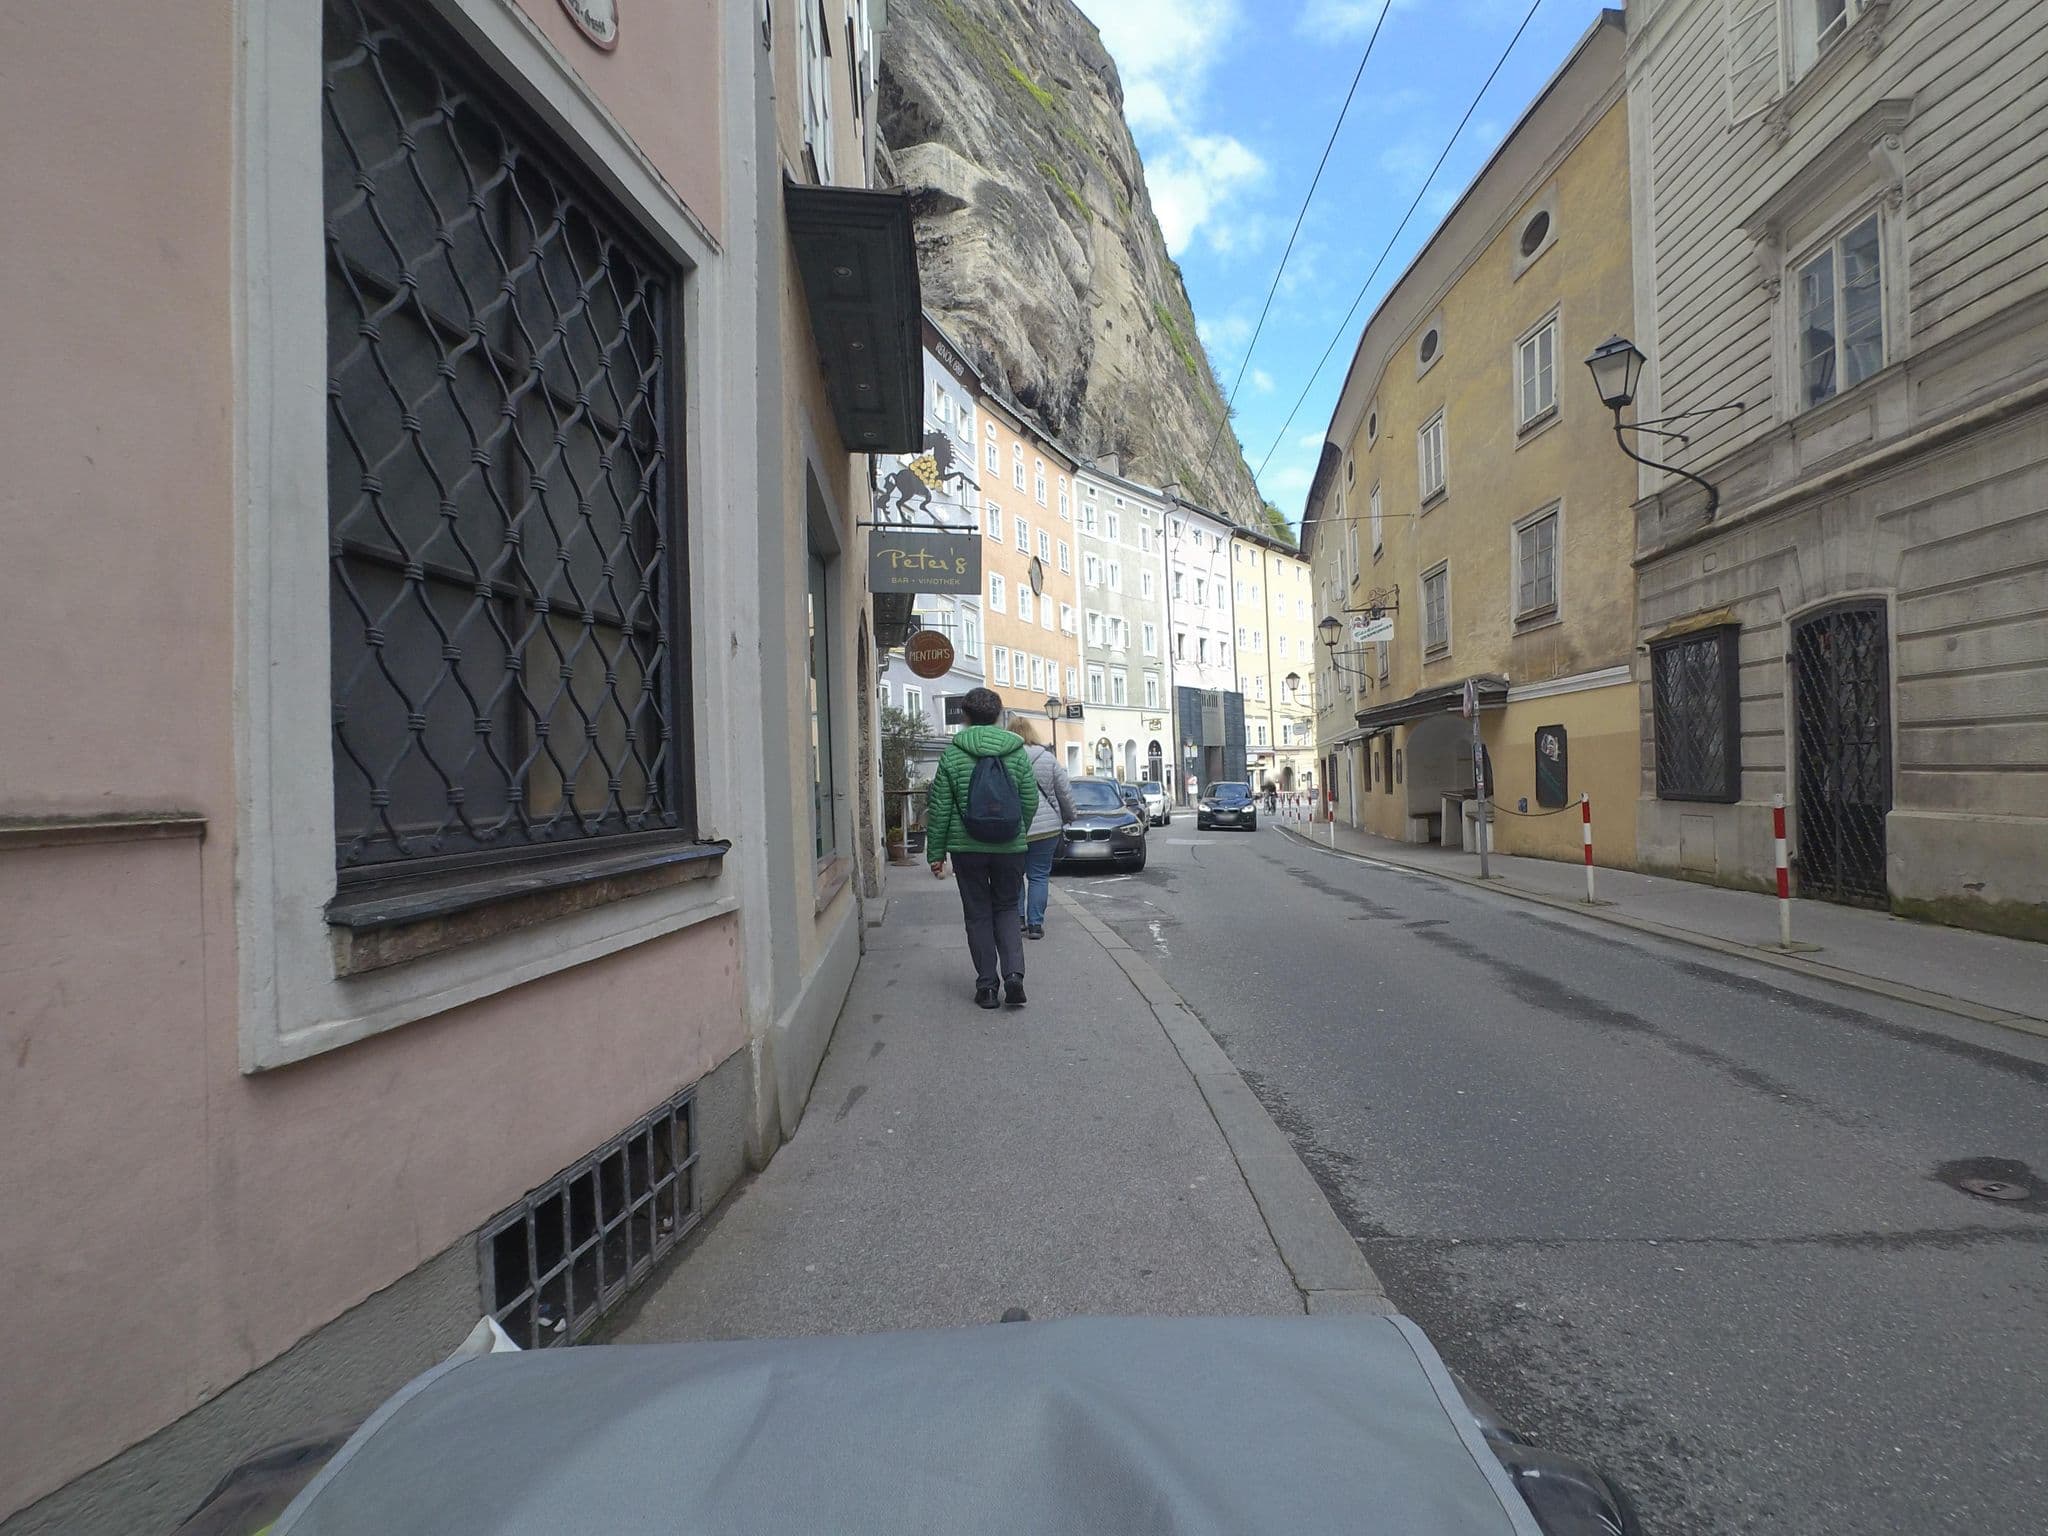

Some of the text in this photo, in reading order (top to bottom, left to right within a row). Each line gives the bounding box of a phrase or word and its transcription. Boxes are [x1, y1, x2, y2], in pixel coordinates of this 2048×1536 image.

[877, 547, 967, 574] Peter's
[919, 577, 960, 585] VINOTHEK
[909, 649, 951, 662] MENTOR'S
